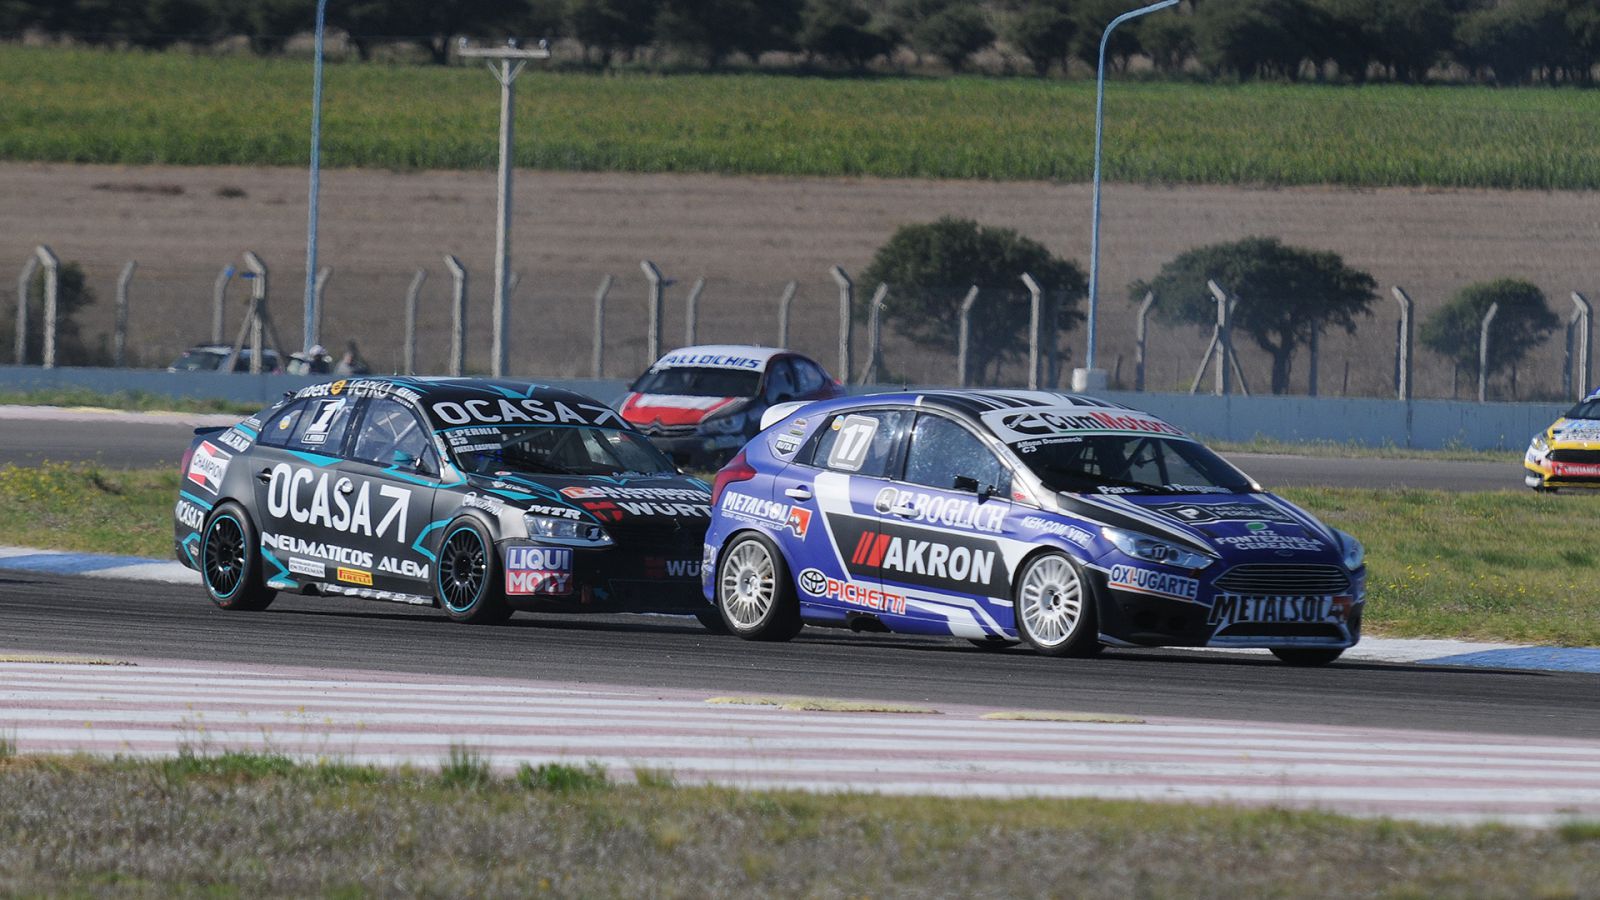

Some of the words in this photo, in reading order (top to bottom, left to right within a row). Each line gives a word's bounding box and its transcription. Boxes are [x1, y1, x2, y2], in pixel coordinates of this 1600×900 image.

[308, 401, 343, 432] 1
[432, 399, 589, 425] OCASA
[445, 427, 502, 439] L.PERNIA
[449, 437, 469, 446] C3
[837, 423, 874, 461] 17
[1022, 445, 1038, 456] C3
[267, 463, 372, 537] OCASA
[528, 504, 583, 520] MTR
[616, 502, 712, 518] WÜRT
[721, 491, 789, 522] METALSOL
[175, 499, 199, 530] OCASA
[588, 527, 600, 540] 1
[1215, 535, 1326, 546] FONTEZUELA
[261, 531, 373, 569] NEUMATICOS
[377, 556, 430, 579] ALEM
[509, 549, 570, 571] LIQUI
[882, 536, 995, 586] AKRON
[1153, 547, 1165, 558] 17
[339, 569, 372, 586] PIRELLI
[508, 572, 571, 593] MOLY
[1111, 565, 1198, 598] OXI-UGARTE
[827, 578, 906, 614] PICHETTI
[1207, 594, 1326, 626] METALSOL
